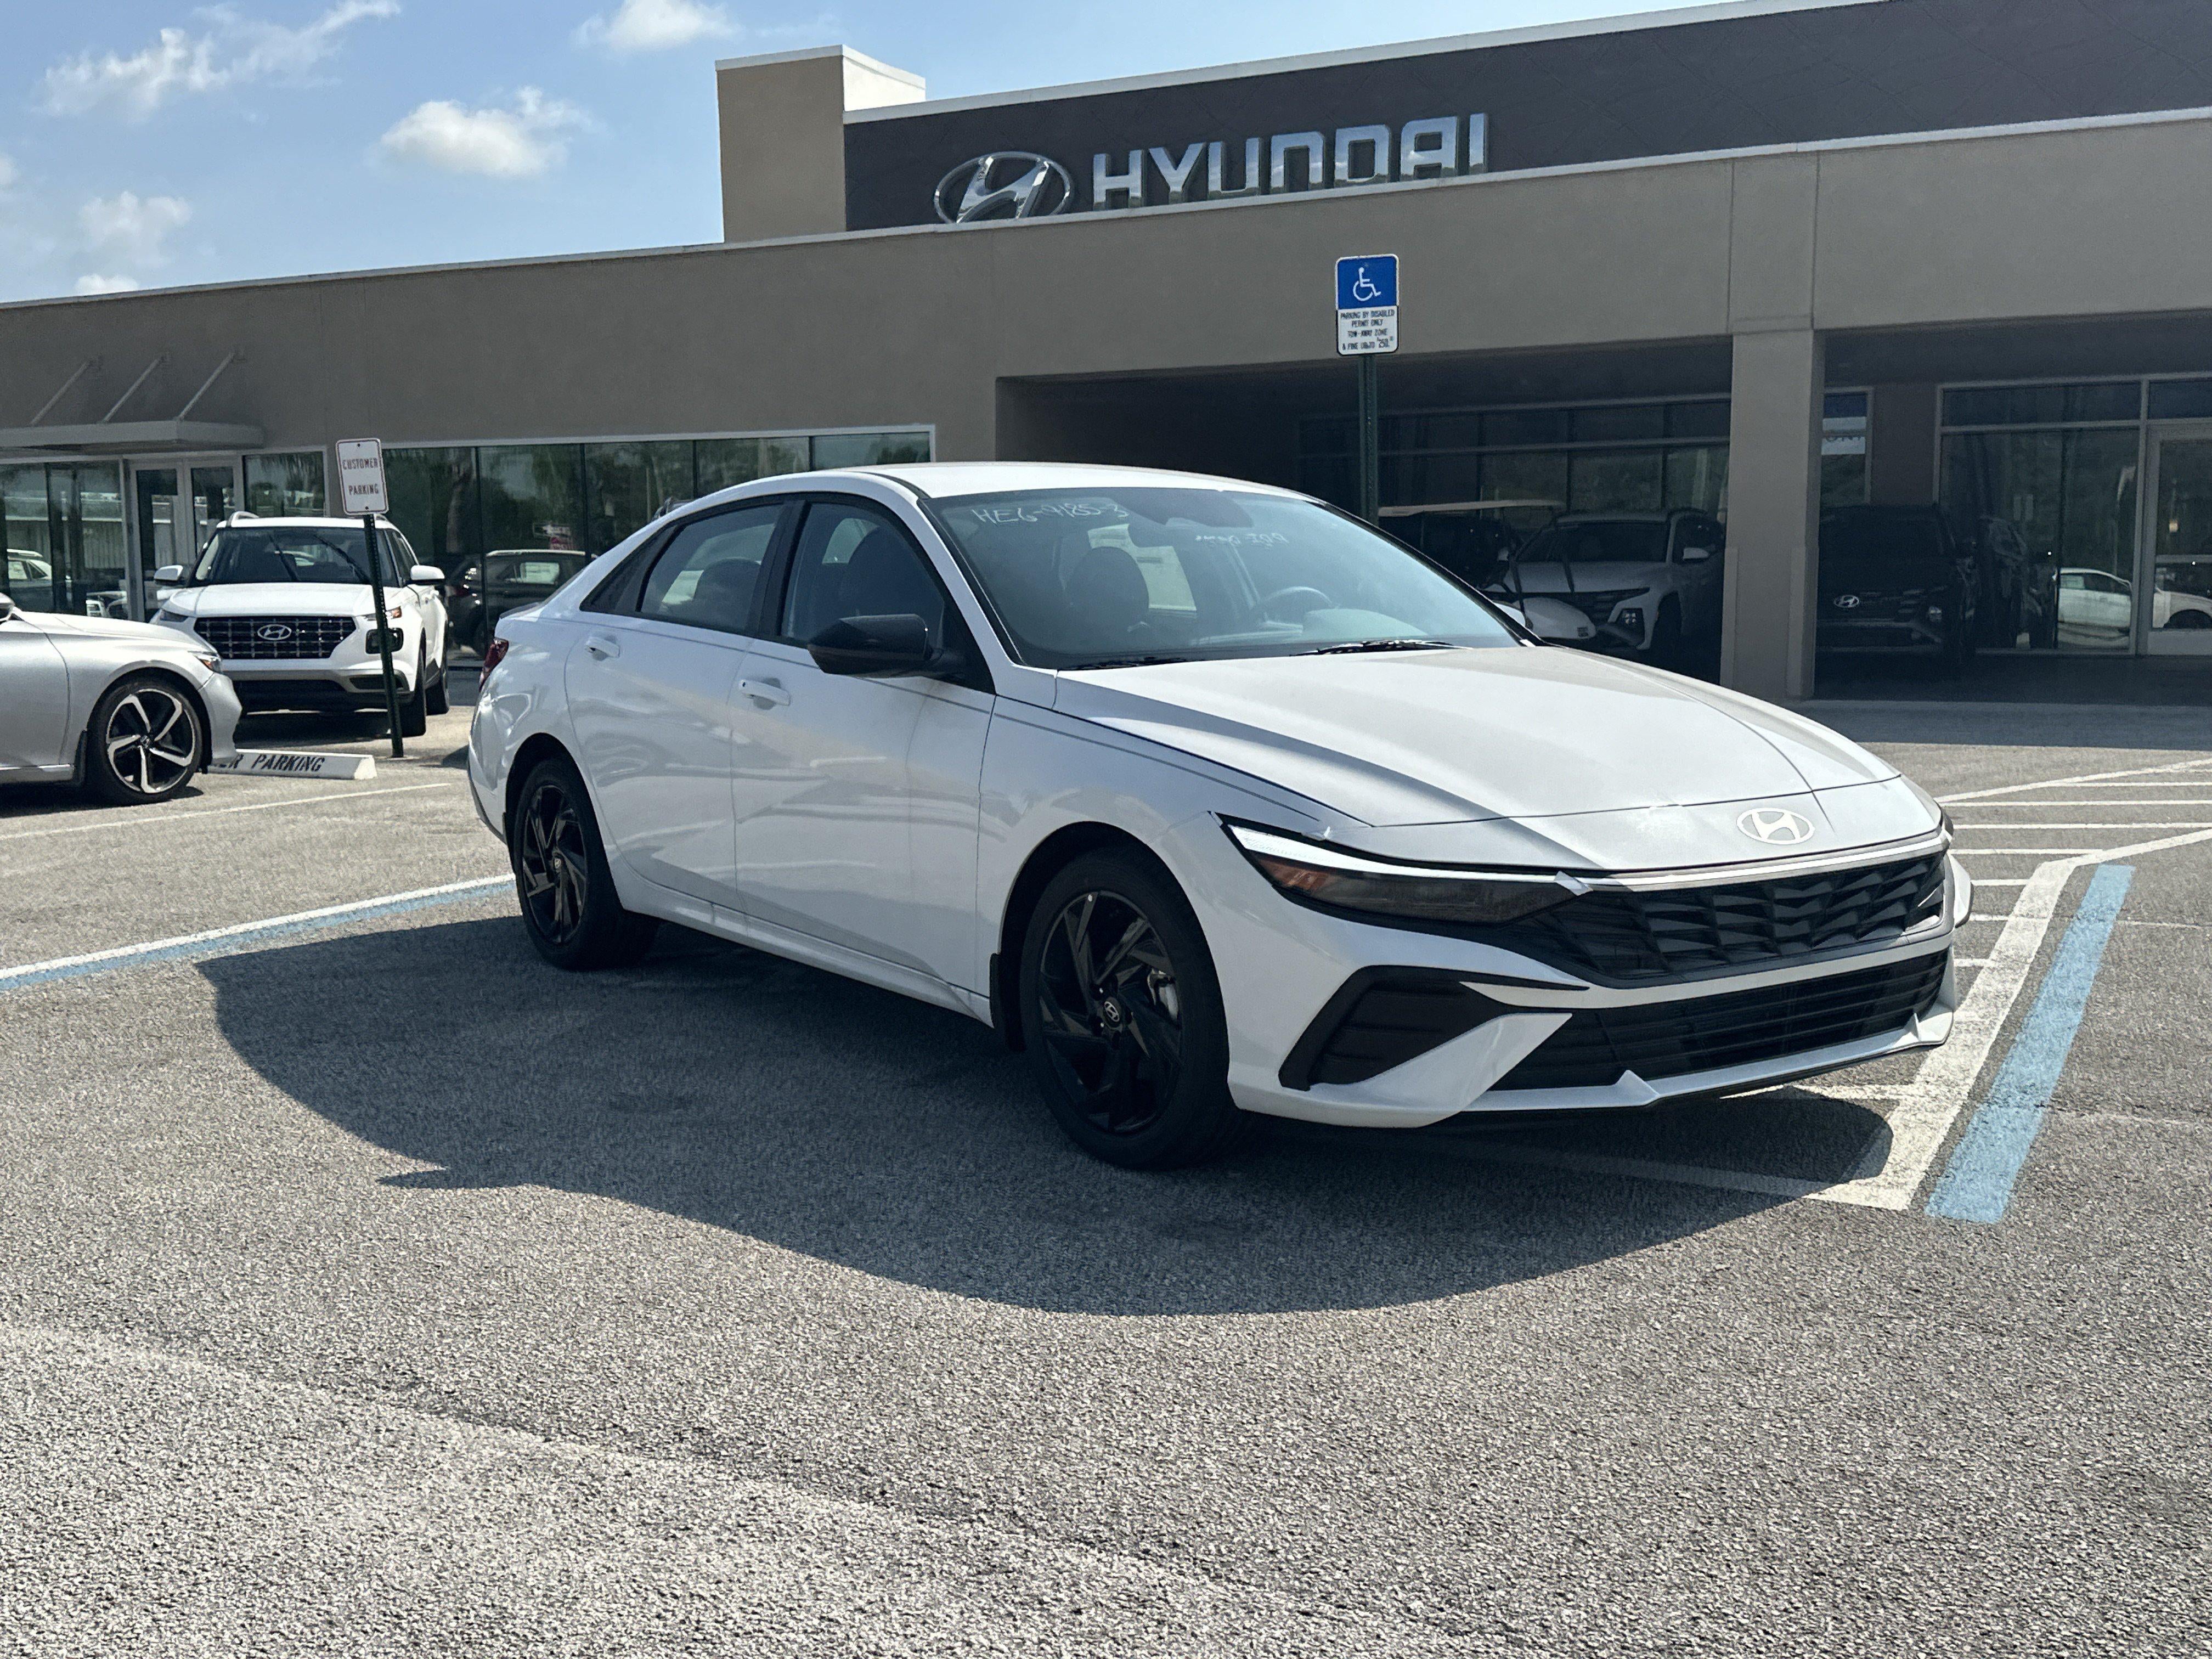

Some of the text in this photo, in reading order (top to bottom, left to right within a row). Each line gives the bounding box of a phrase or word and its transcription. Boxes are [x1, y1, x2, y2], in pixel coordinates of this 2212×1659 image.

[1093, 113, 1489, 211] HYUNDAI
[342, 458, 378, 470] CUSTOMER
[348, 483, 379, 495] PARKING
[252, 754, 325, 772] PARKING
